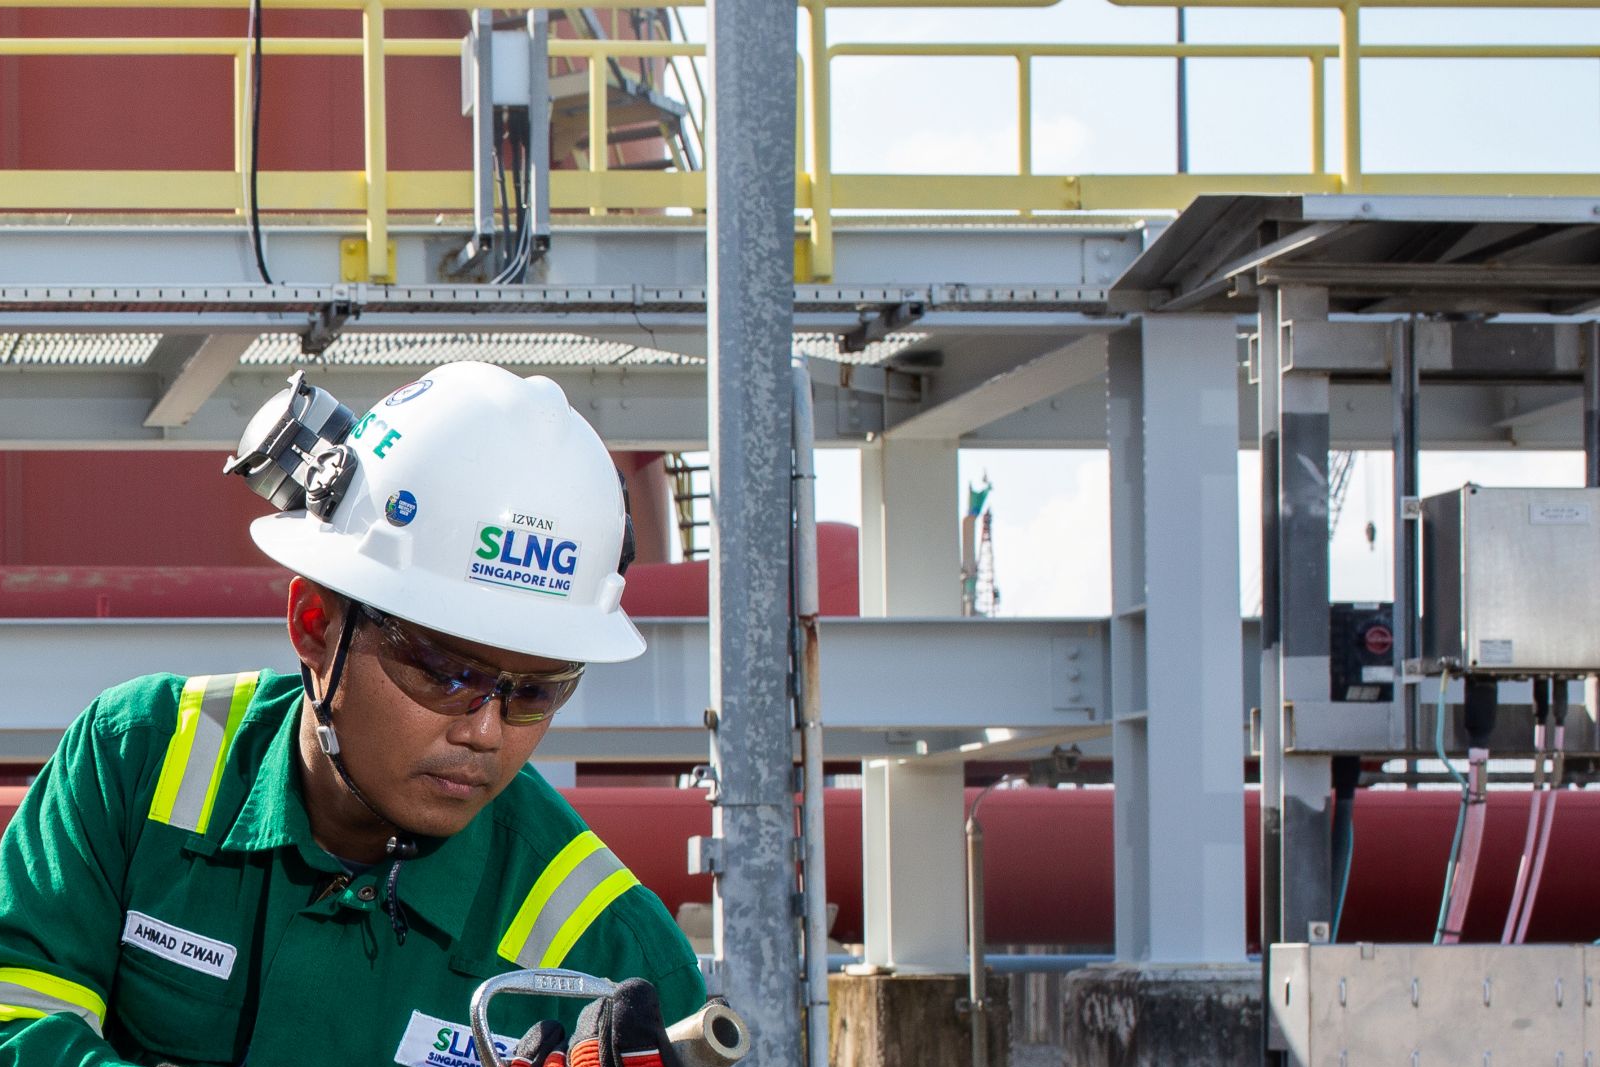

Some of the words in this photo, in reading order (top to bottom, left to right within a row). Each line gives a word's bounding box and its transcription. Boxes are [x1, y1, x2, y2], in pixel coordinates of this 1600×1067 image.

[511, 513, 553, 531] IZWAN
[475, 526, 577, 576] SLNG
[471, 562, 547, 587] SINGAPORE
[549, 577, 571, 591] LNG
[134, 923, 177, 950] AHMAD
[180, 941, 224, 967] IZWAN
